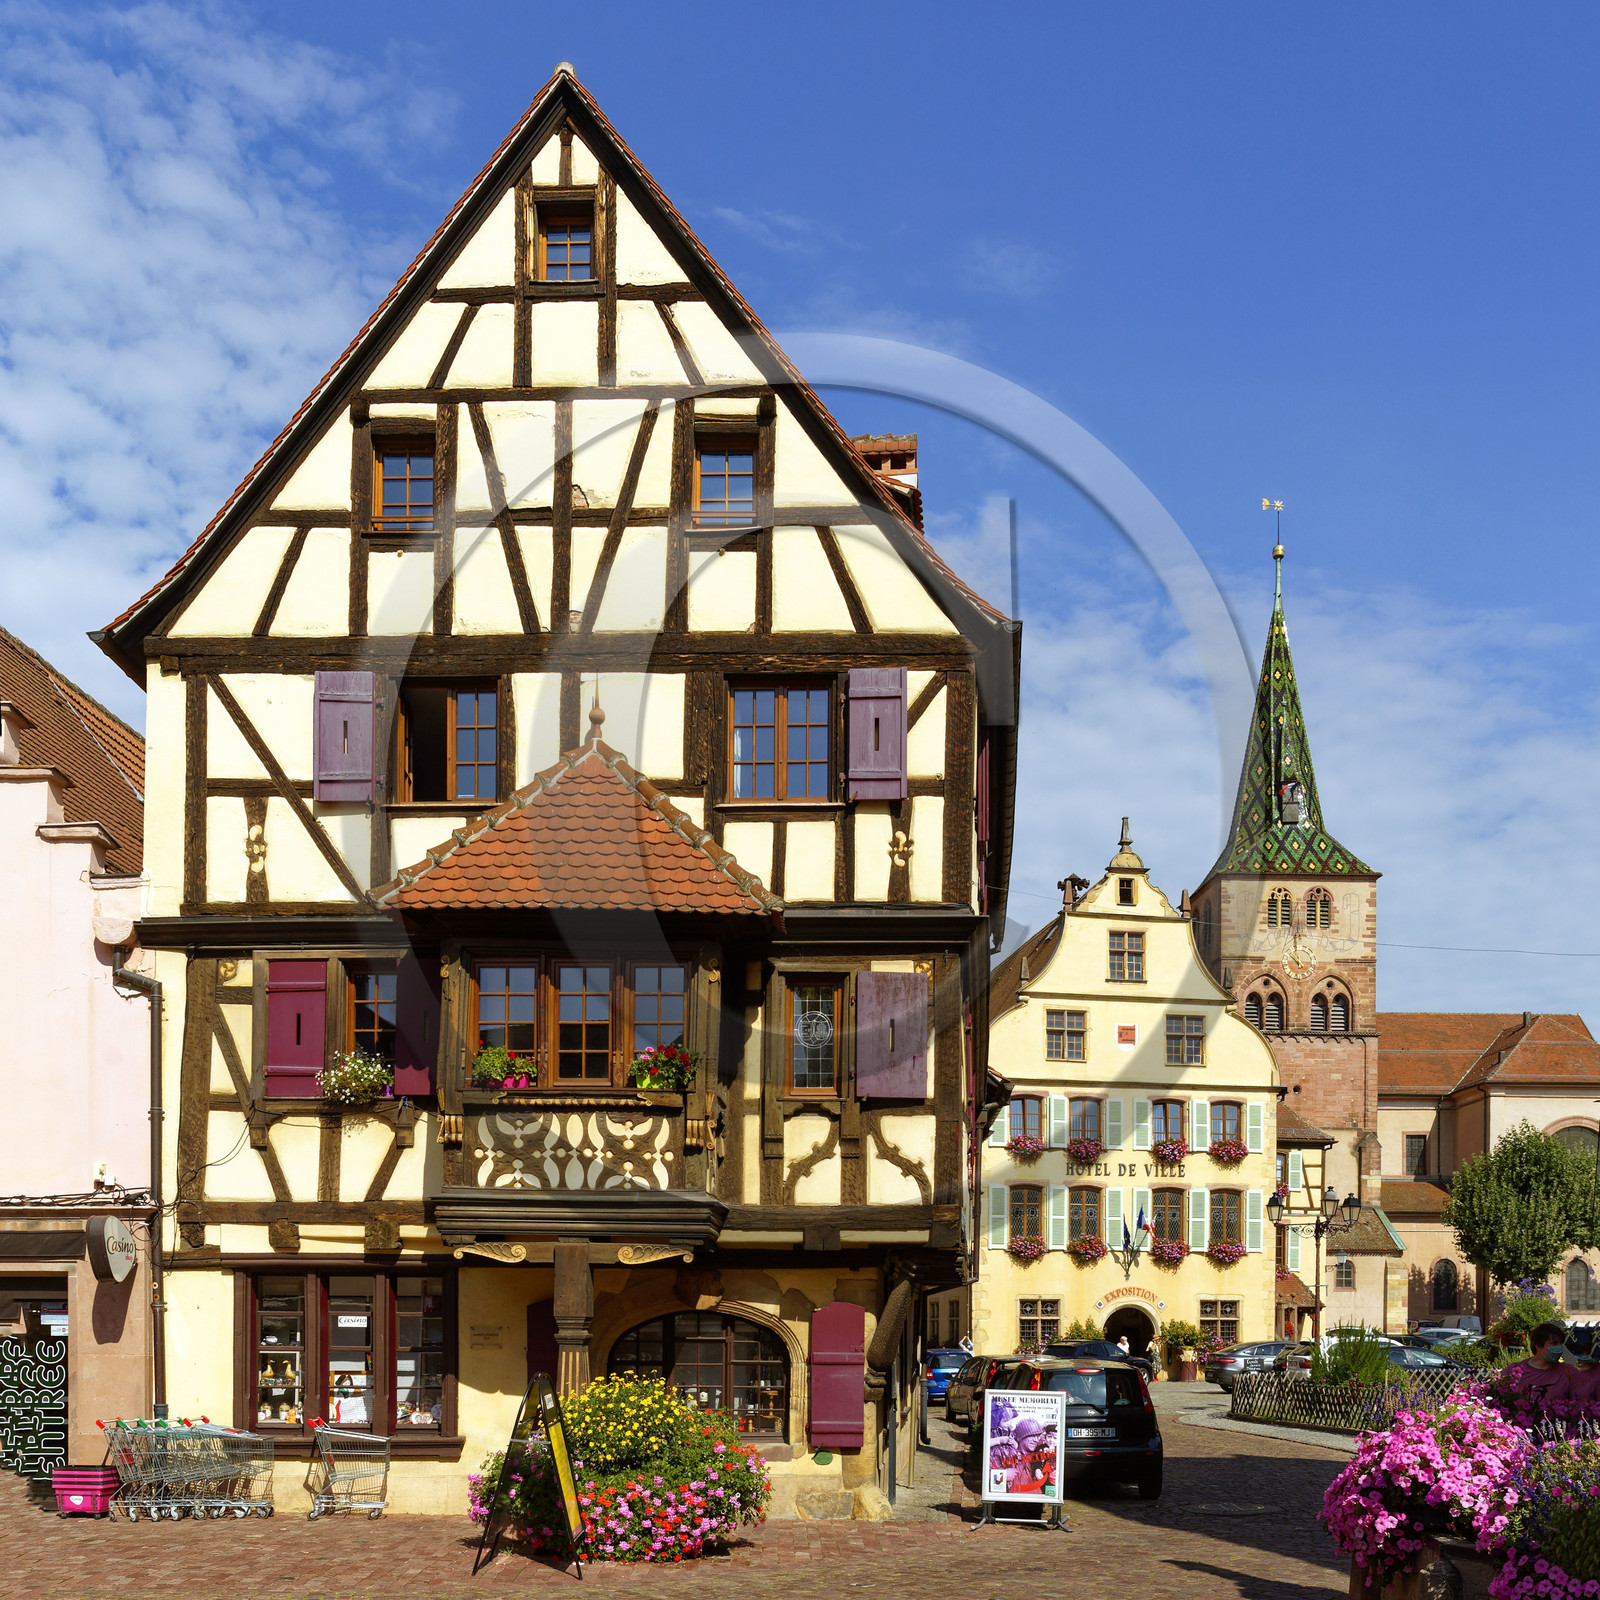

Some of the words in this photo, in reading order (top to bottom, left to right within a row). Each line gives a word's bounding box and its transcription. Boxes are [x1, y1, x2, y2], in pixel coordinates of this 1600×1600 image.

[1118, 1163, 1137, 1177] DE
[1144, 1163, 1186, 1178] VILLE
[107, 1235, 134, 1255] Casino
[1104, 1286, 1158, 1303] EXPOSITION
[338, 1316, 367, 1324] Casino
